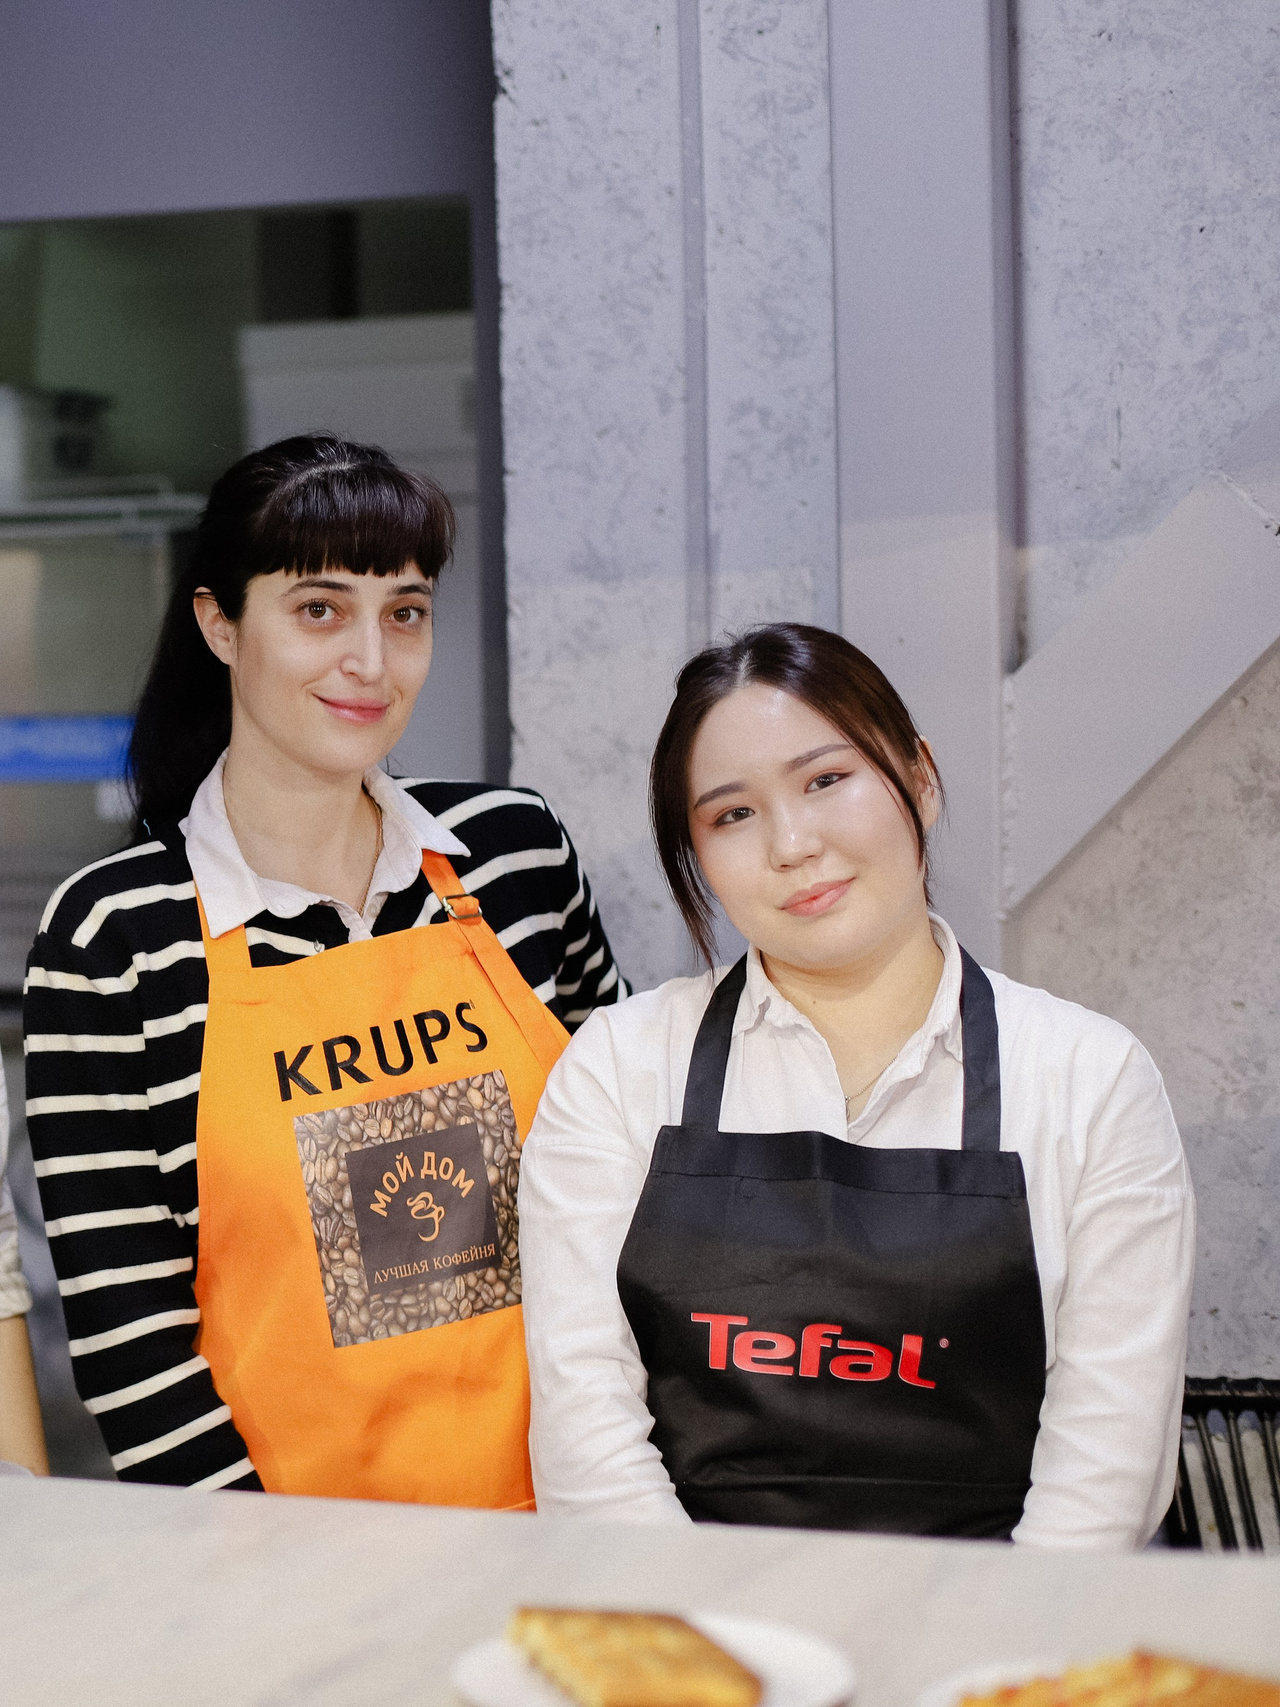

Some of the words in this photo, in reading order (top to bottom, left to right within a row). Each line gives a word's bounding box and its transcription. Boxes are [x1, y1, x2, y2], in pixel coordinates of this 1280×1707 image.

[273, 1002, 488, 1102] KRUPS
[369, 1151, 415, 1217] МОЙ
[420, 1151, 475, 1198] ДОМ
[374, 1259, 430, 1284] ЛУЧШАЯ
[432, 1243, 496, 1270] КОФЕЙНЯ
